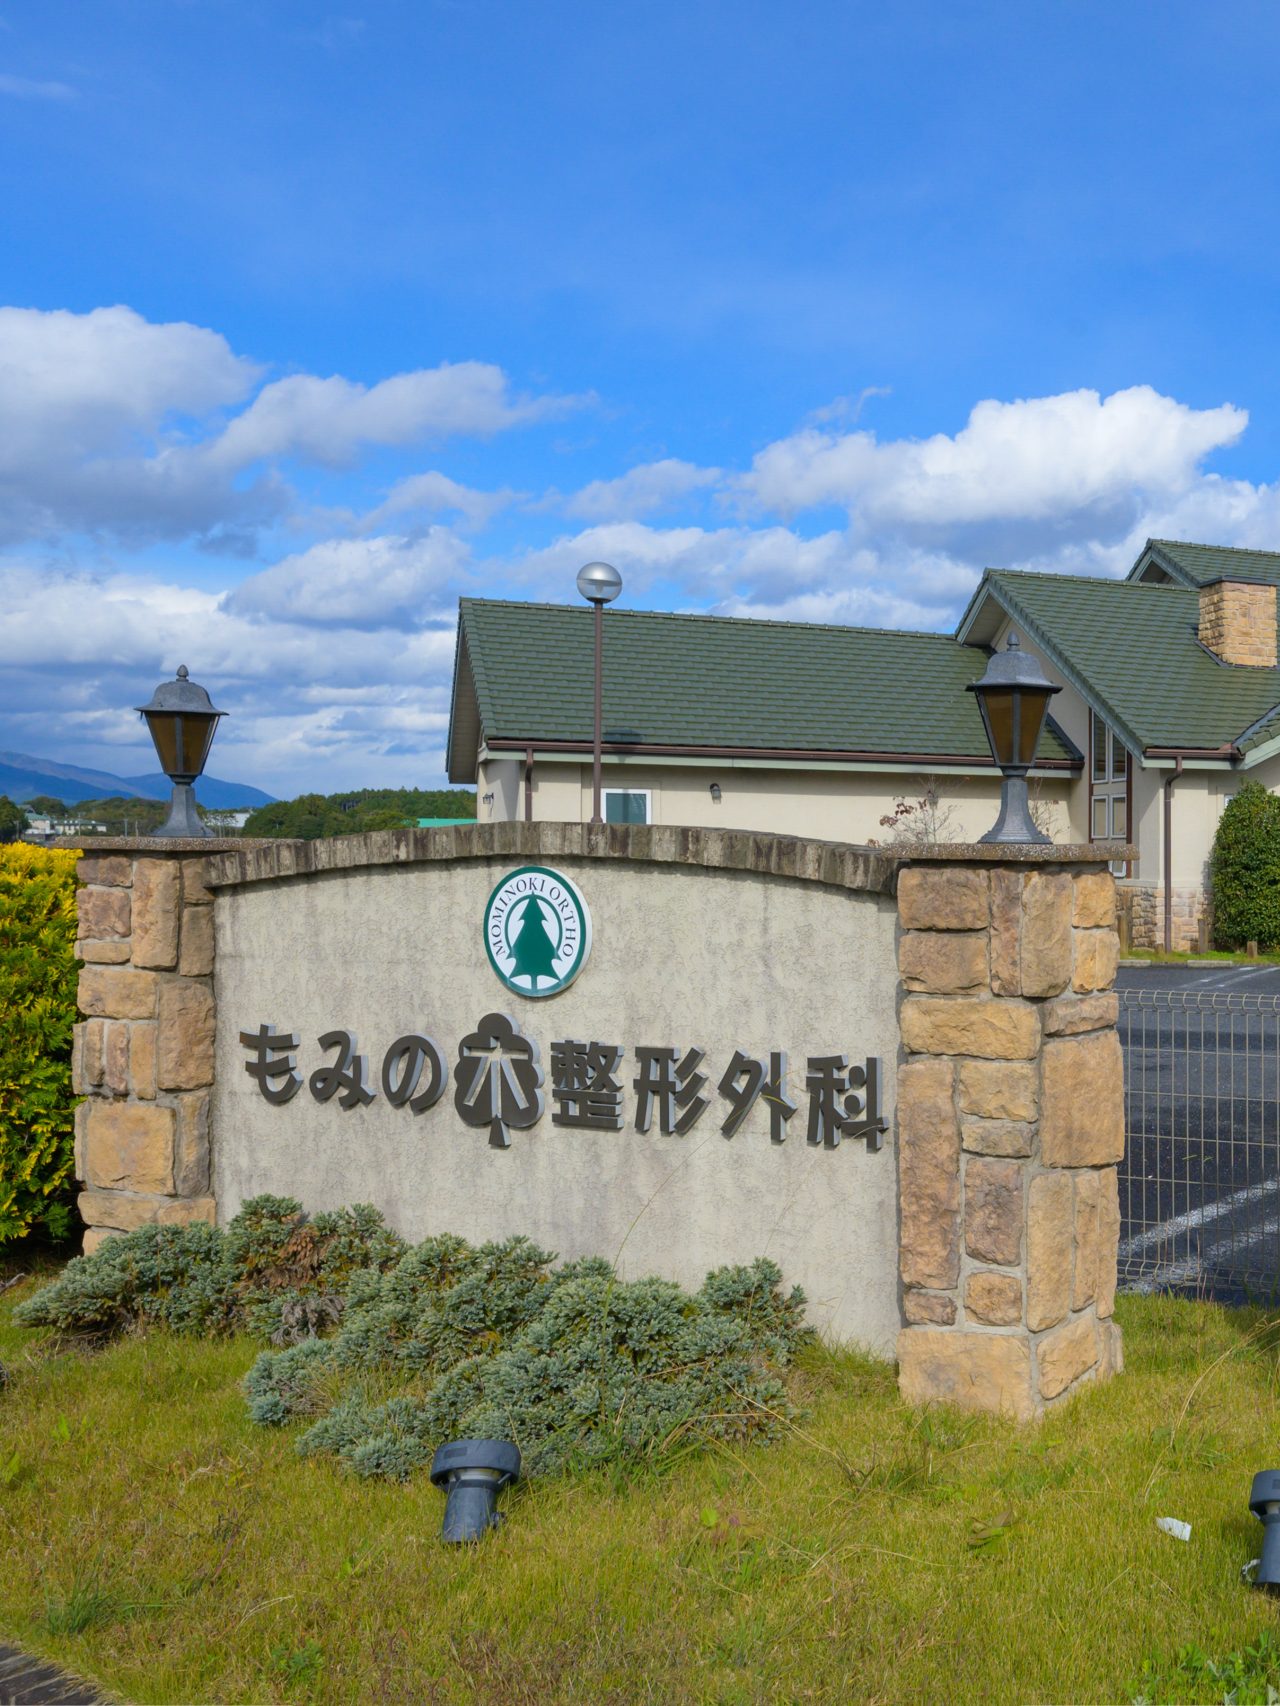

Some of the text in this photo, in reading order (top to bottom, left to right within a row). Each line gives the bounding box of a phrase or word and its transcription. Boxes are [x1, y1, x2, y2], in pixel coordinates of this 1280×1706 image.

[491, 877, 576, 957] MOMINOKI ORTHO
[240, 1013, 890, 1152] もみの木整形外科
